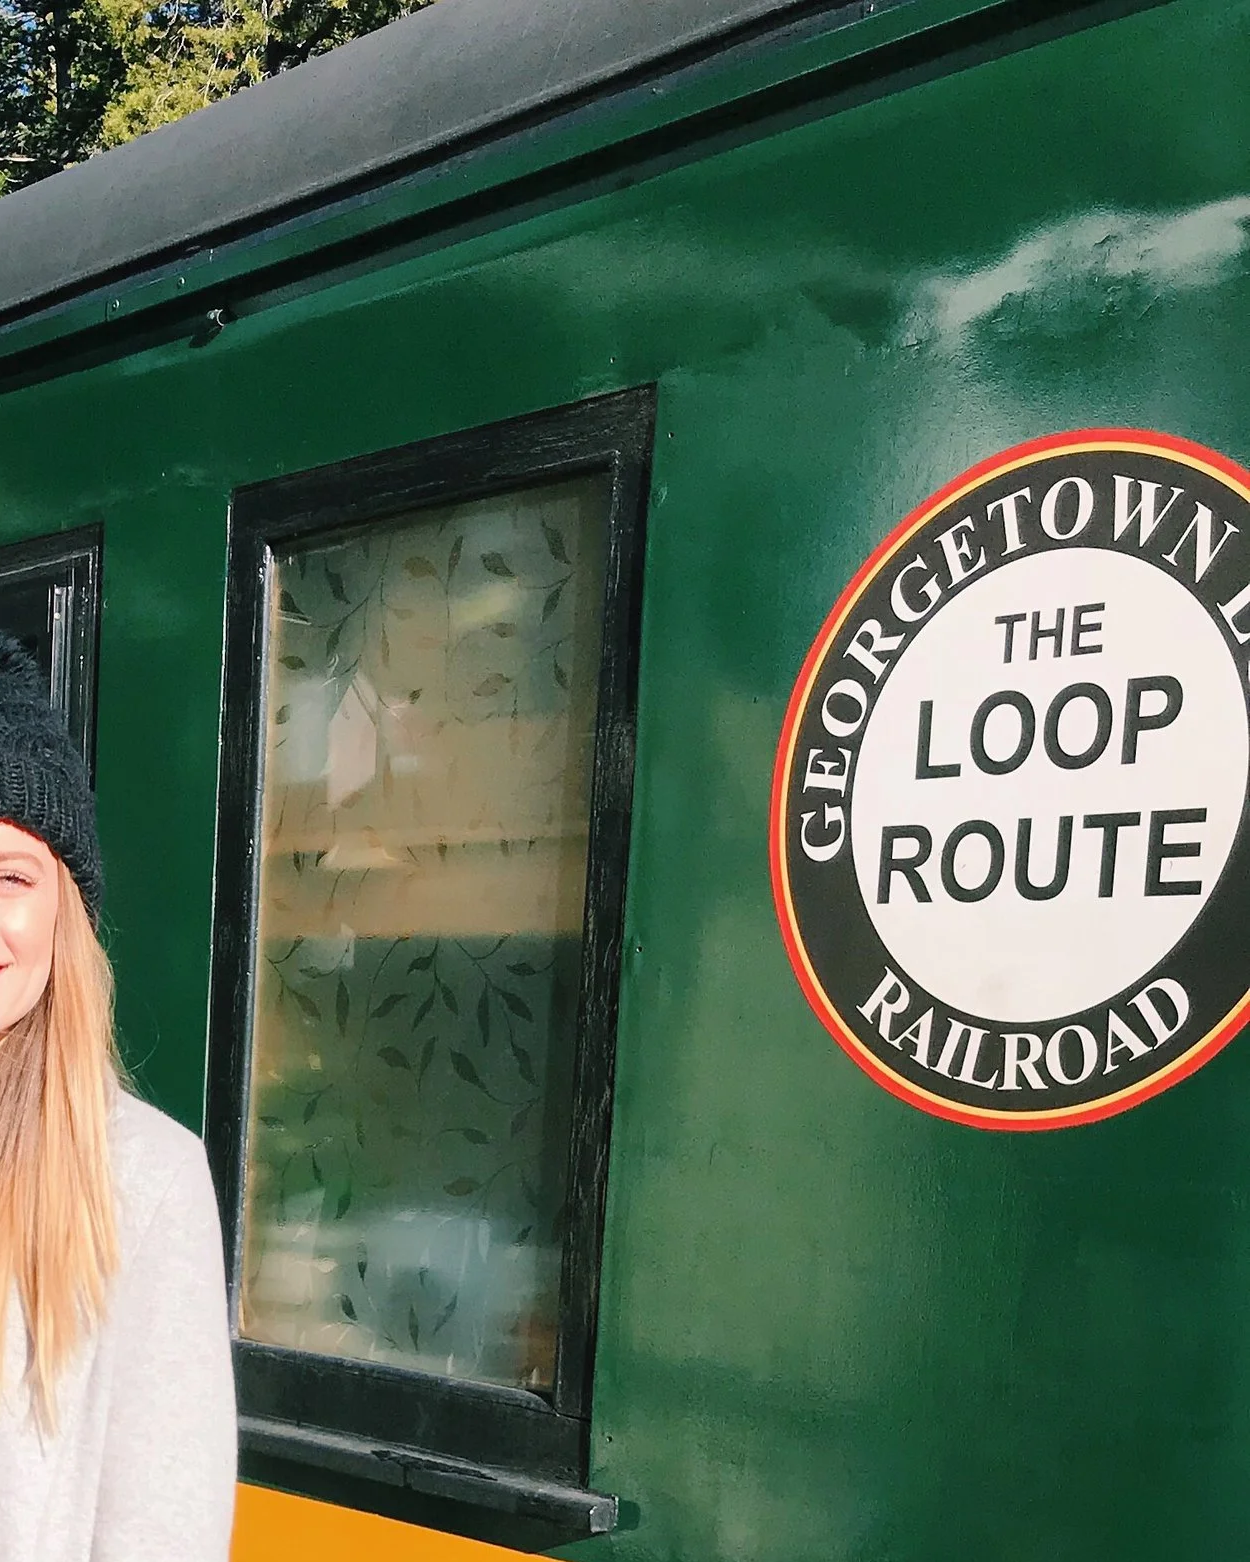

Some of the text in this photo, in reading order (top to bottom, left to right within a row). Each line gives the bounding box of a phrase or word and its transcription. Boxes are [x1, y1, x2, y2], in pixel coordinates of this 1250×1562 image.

[799, 474, 1240, 862] GEORGETOWN
[994, 602, 1107, 664] THE
[914, 674, 1184, 780] LOOP
[875, 807, 1208, 905] ROUTE
[856, 966, 1190, 1091] RAILROAD
